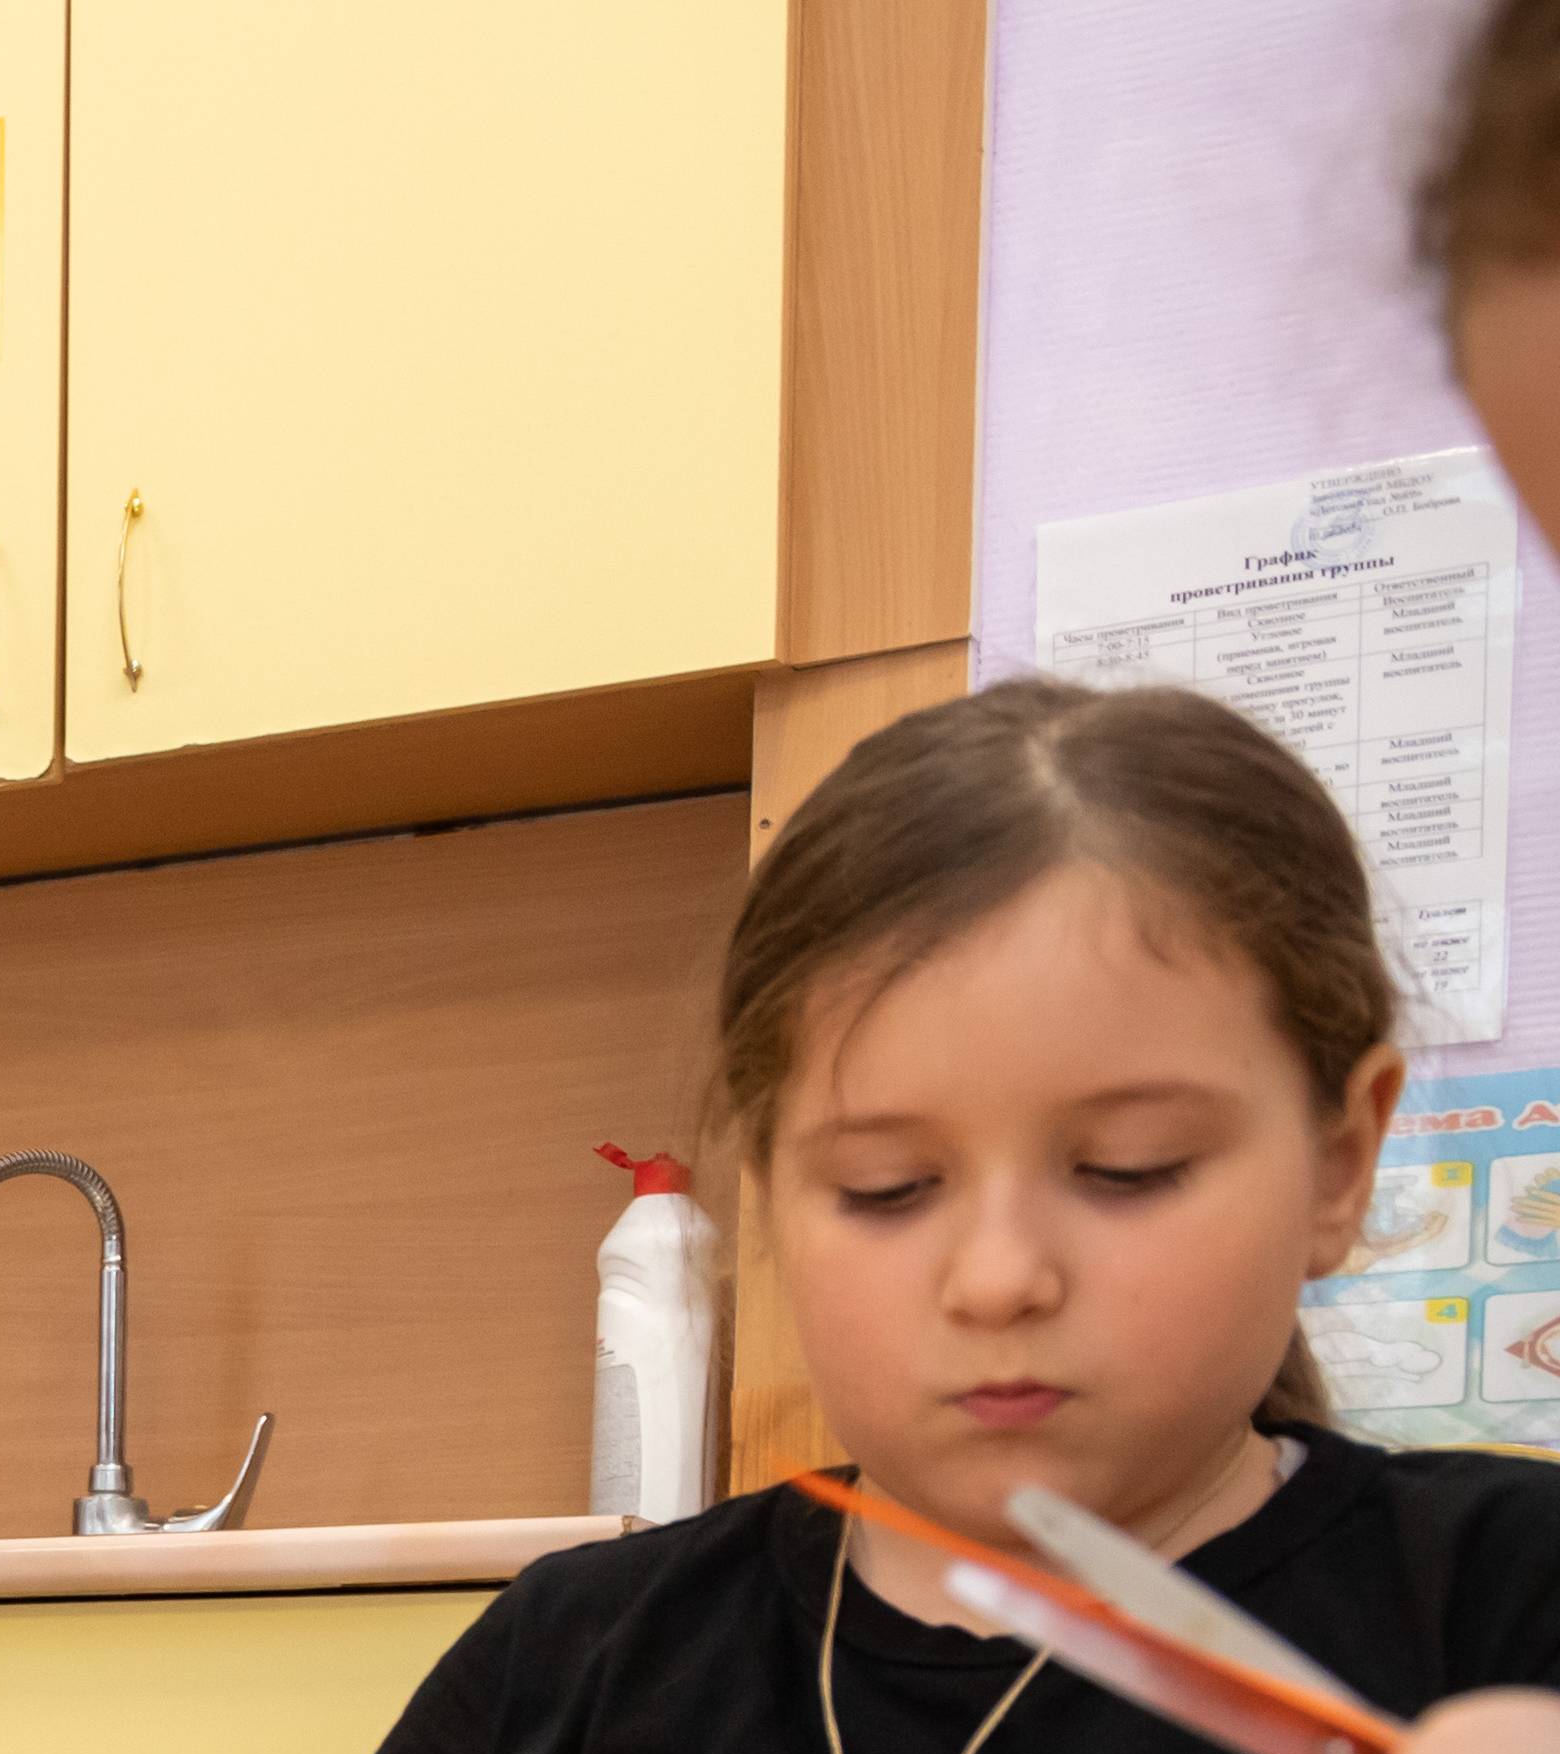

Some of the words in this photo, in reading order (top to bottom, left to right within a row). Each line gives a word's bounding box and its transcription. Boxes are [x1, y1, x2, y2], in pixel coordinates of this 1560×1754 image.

[1244, 548, 1318, 571] График
[1170, 568, 1315, 604] проветривания
[1321, 555, 1394, 580] группы
[1517, 1103, 1560, 1127] А
[1436, 1302, 1458, 1319] 4
